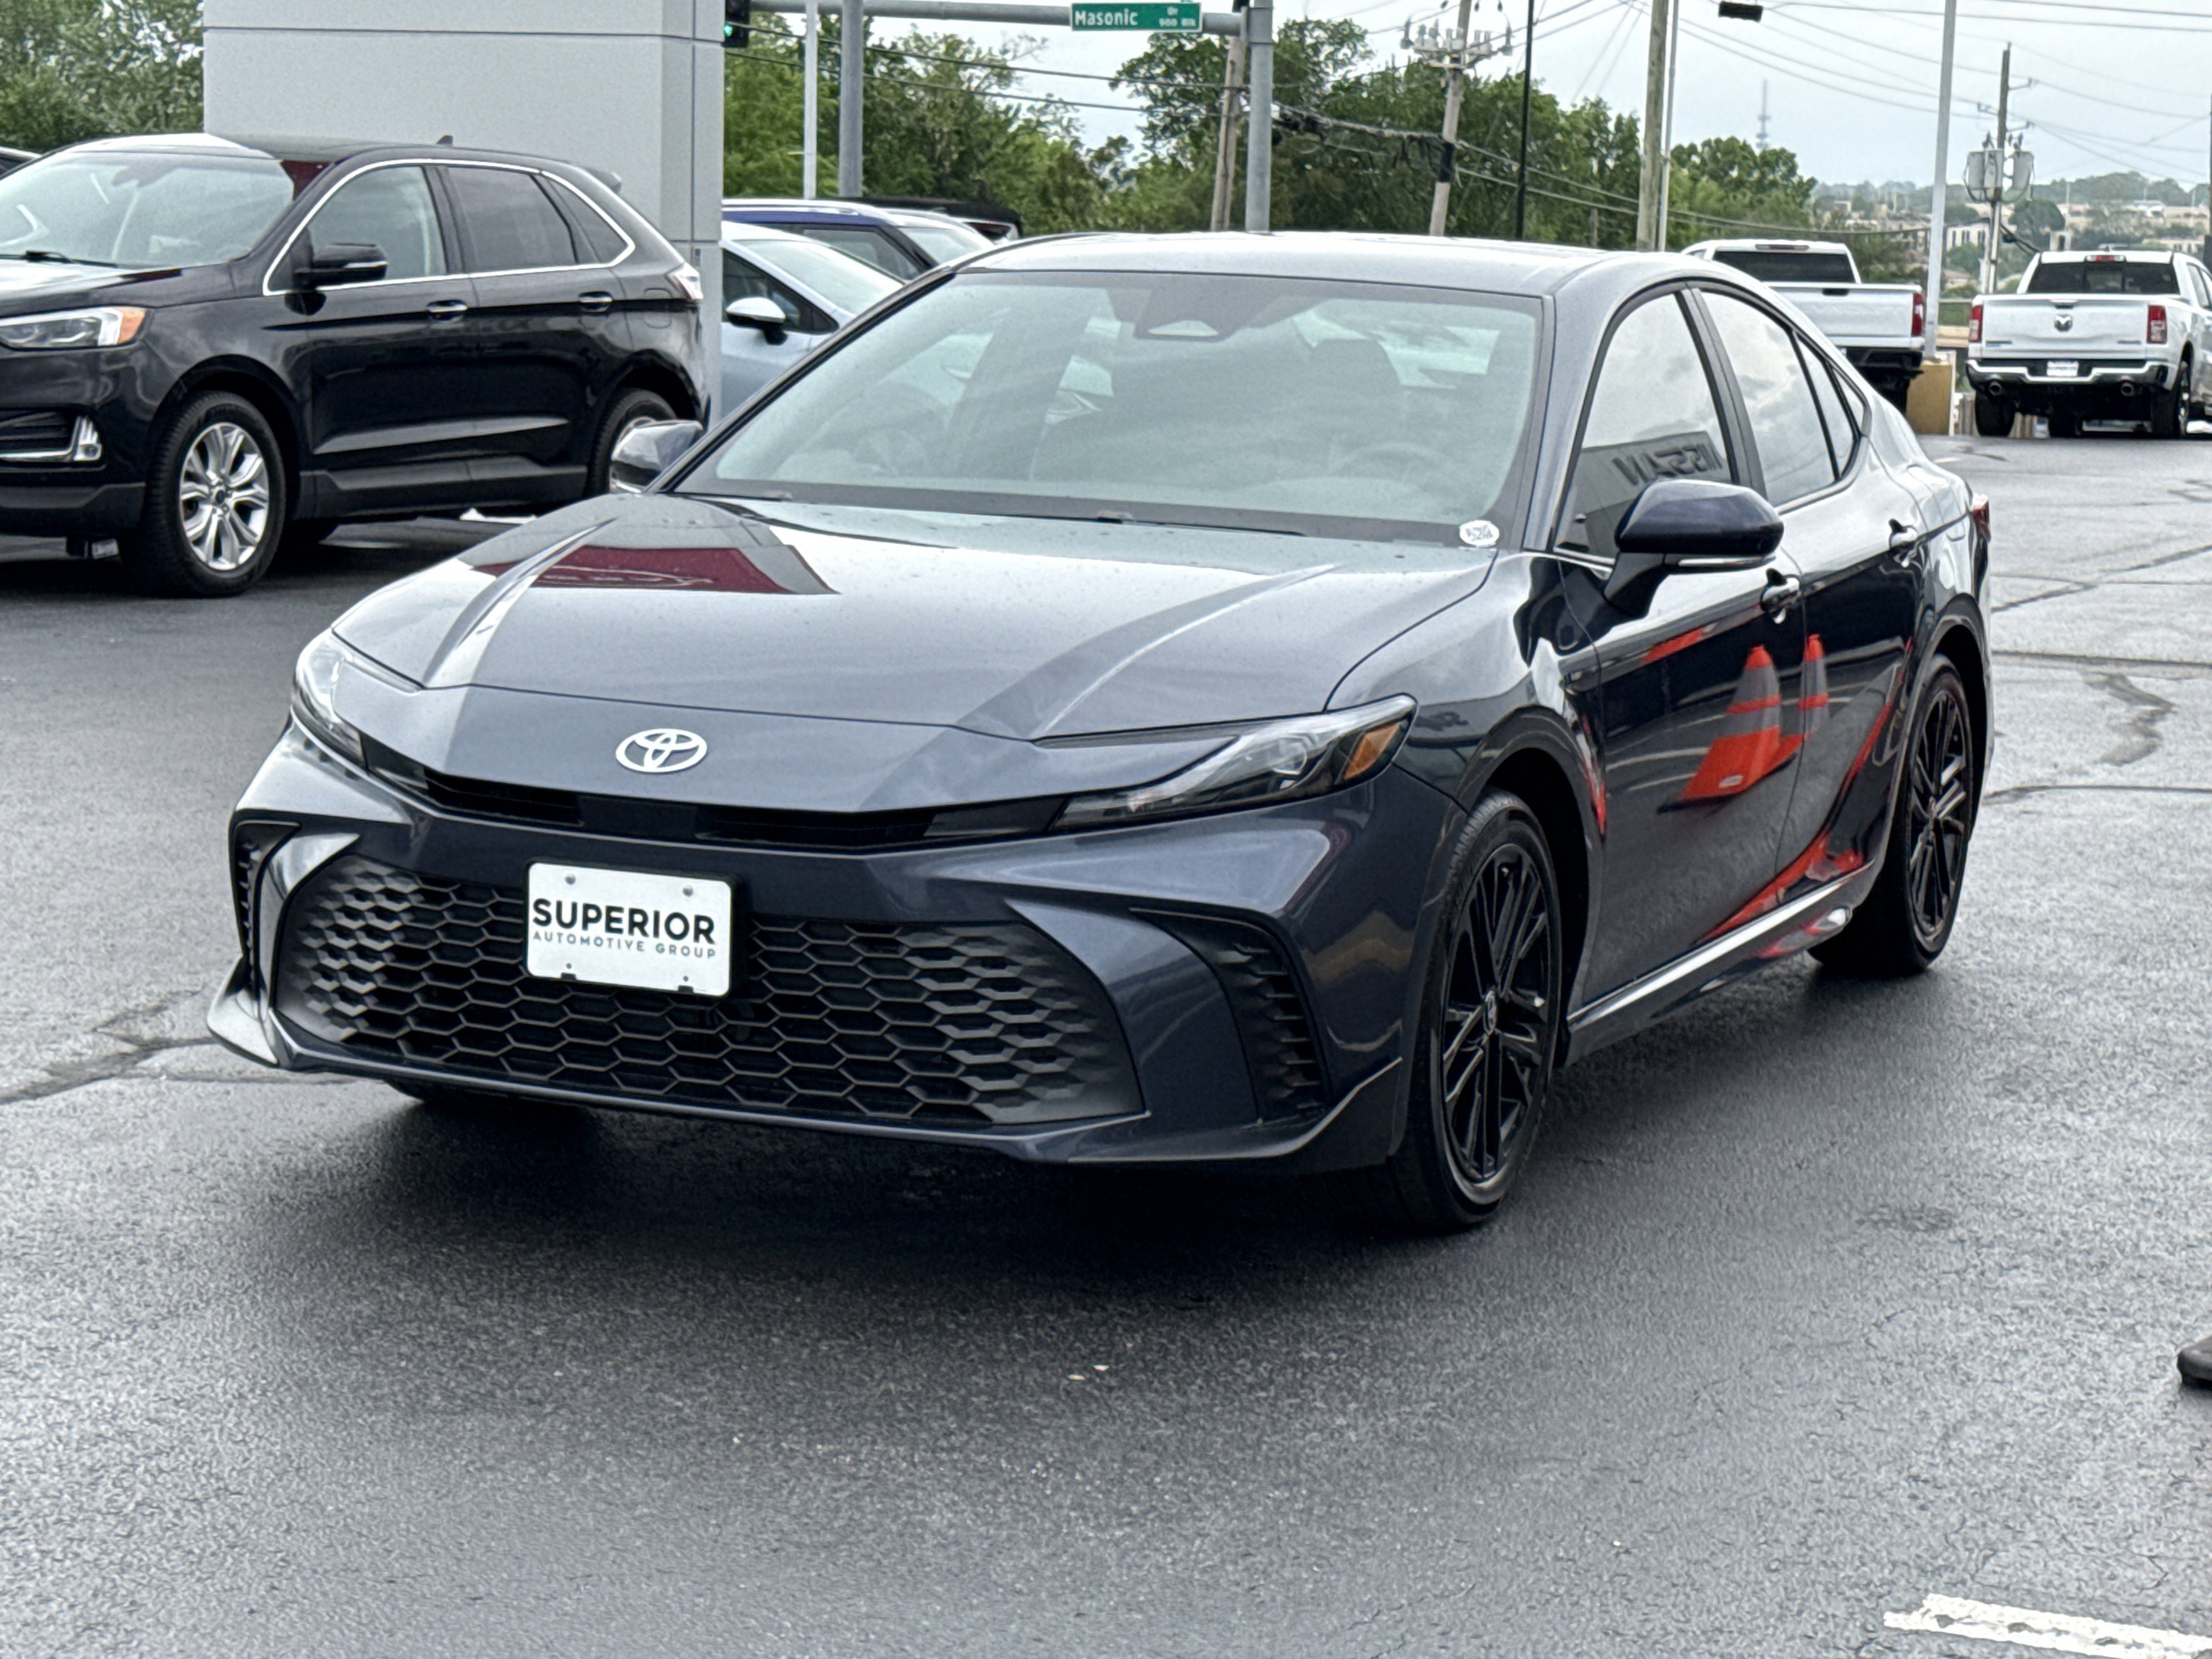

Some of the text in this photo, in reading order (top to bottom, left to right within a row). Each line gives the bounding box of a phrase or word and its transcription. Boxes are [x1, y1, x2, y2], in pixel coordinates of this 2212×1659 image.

[1075, 8, 1138, 26] Masonic
[532, 898, 716, 945] SUPERIOR
[532, 930, 716, 959] AUTOMOTIVE GROUP
